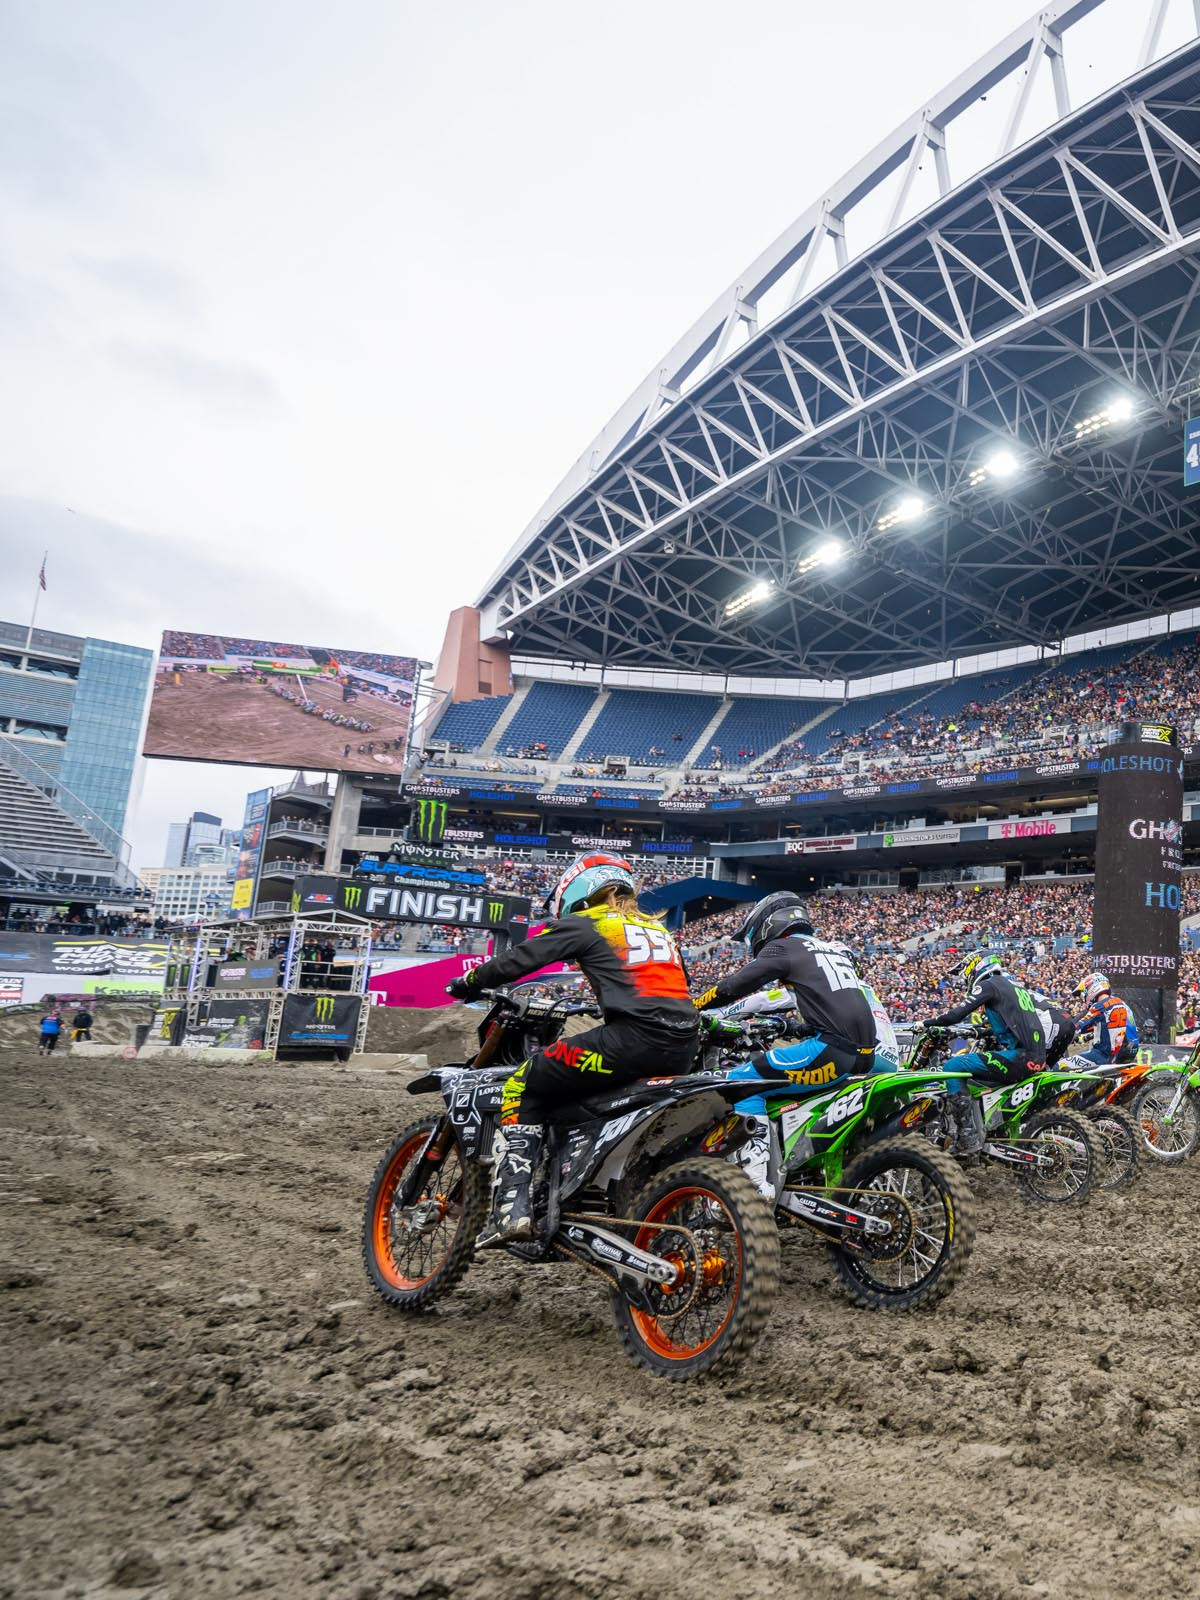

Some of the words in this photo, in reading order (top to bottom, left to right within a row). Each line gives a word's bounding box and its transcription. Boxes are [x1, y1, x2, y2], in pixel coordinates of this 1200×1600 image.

[393, 842, 460, 860] MONSTER
[787, 841, 803, 853] EQC
[360, 860, 486, 885] SUPERCROSS
[394, 874, 451, 889] Championship
[365, 886, 484, 923] FINISH
[52, 944, 155, 958] SUPER
[989, 941, 1009, 949] DELT
[1092, 955, 1176, 970] HOSTBUSTERS
[95, 985, 161, 995] Kawas
[1014, 987, 1035, 1013] 88
[784, 1061, 838, 1085] THOR
[1011, 1082, 1034, 1106] 88
[825, 1087, 864, 1127] 162
